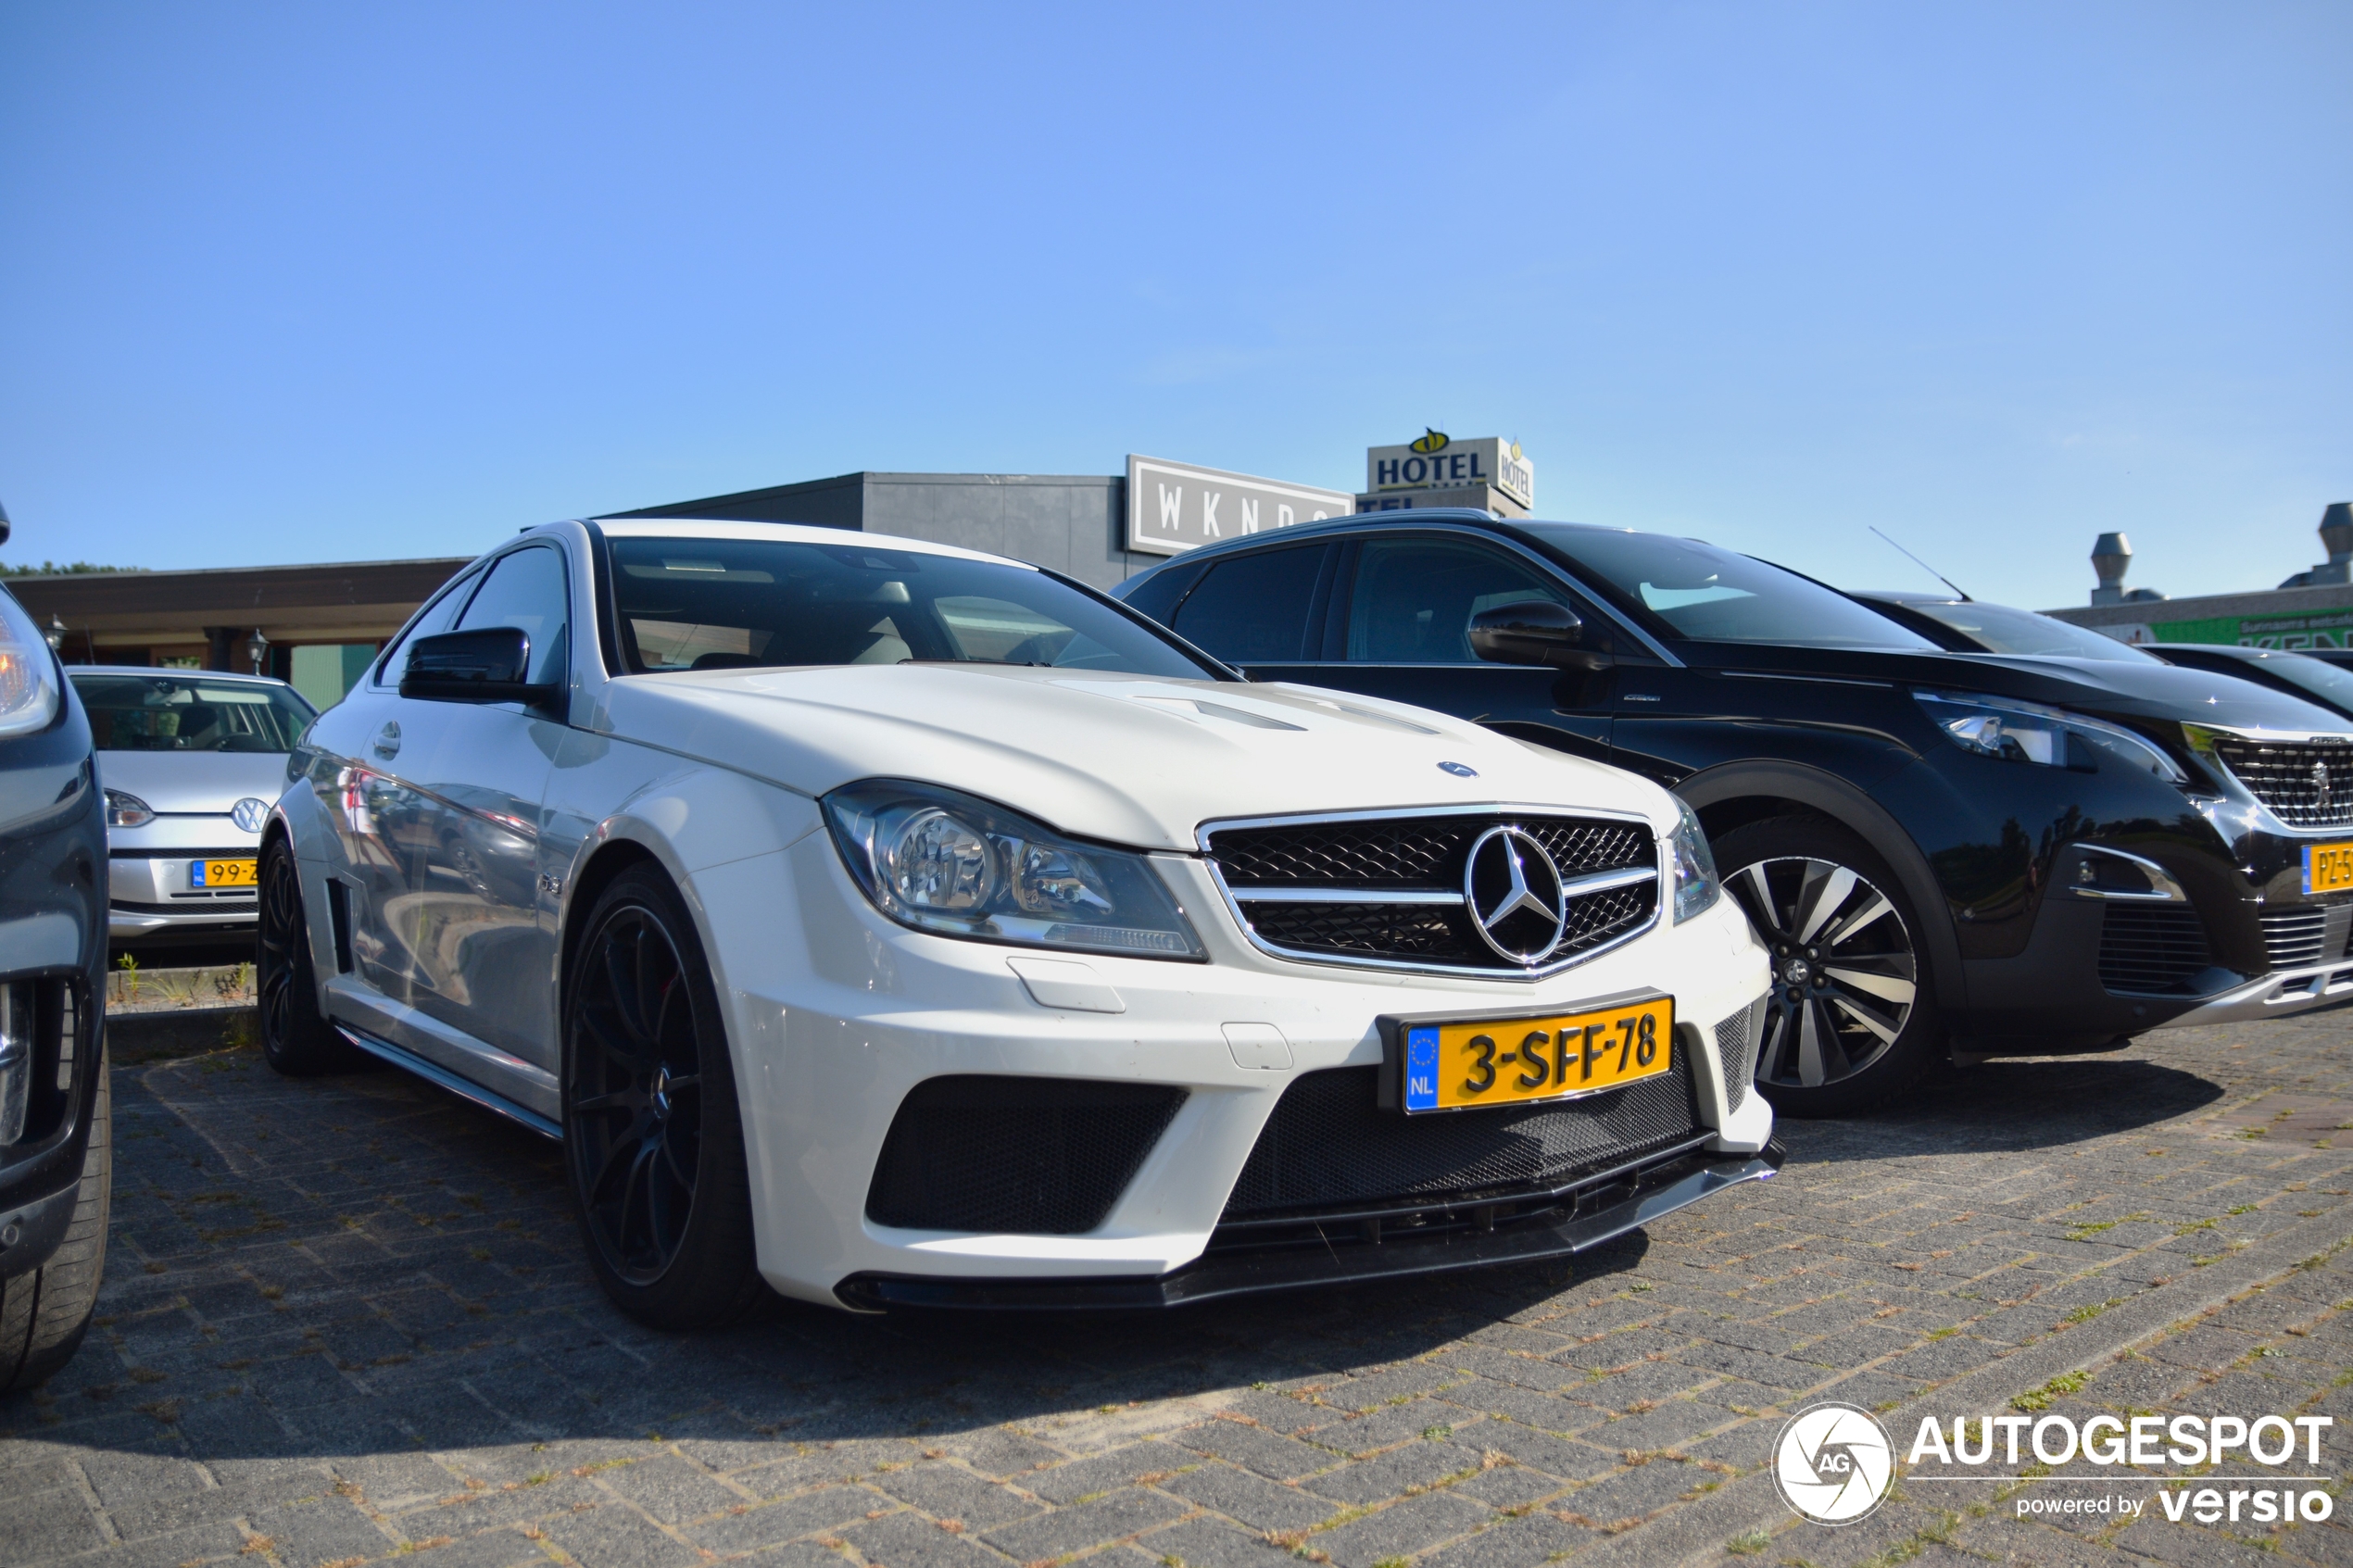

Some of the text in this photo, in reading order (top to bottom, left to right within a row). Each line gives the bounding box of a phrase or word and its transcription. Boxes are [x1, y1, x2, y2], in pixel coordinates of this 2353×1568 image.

[1378, 453, 1487, 484] HOTEL
[1501, 454, 1530, 497] HOTEL
[1159, 483, 1328, 537] WKND
[2318, 847, 2353, 885] PZ-5
[1466, 1012, 1657, 1093] 3-SFF-78
[1411, 1077, 1434, 1097] NL
